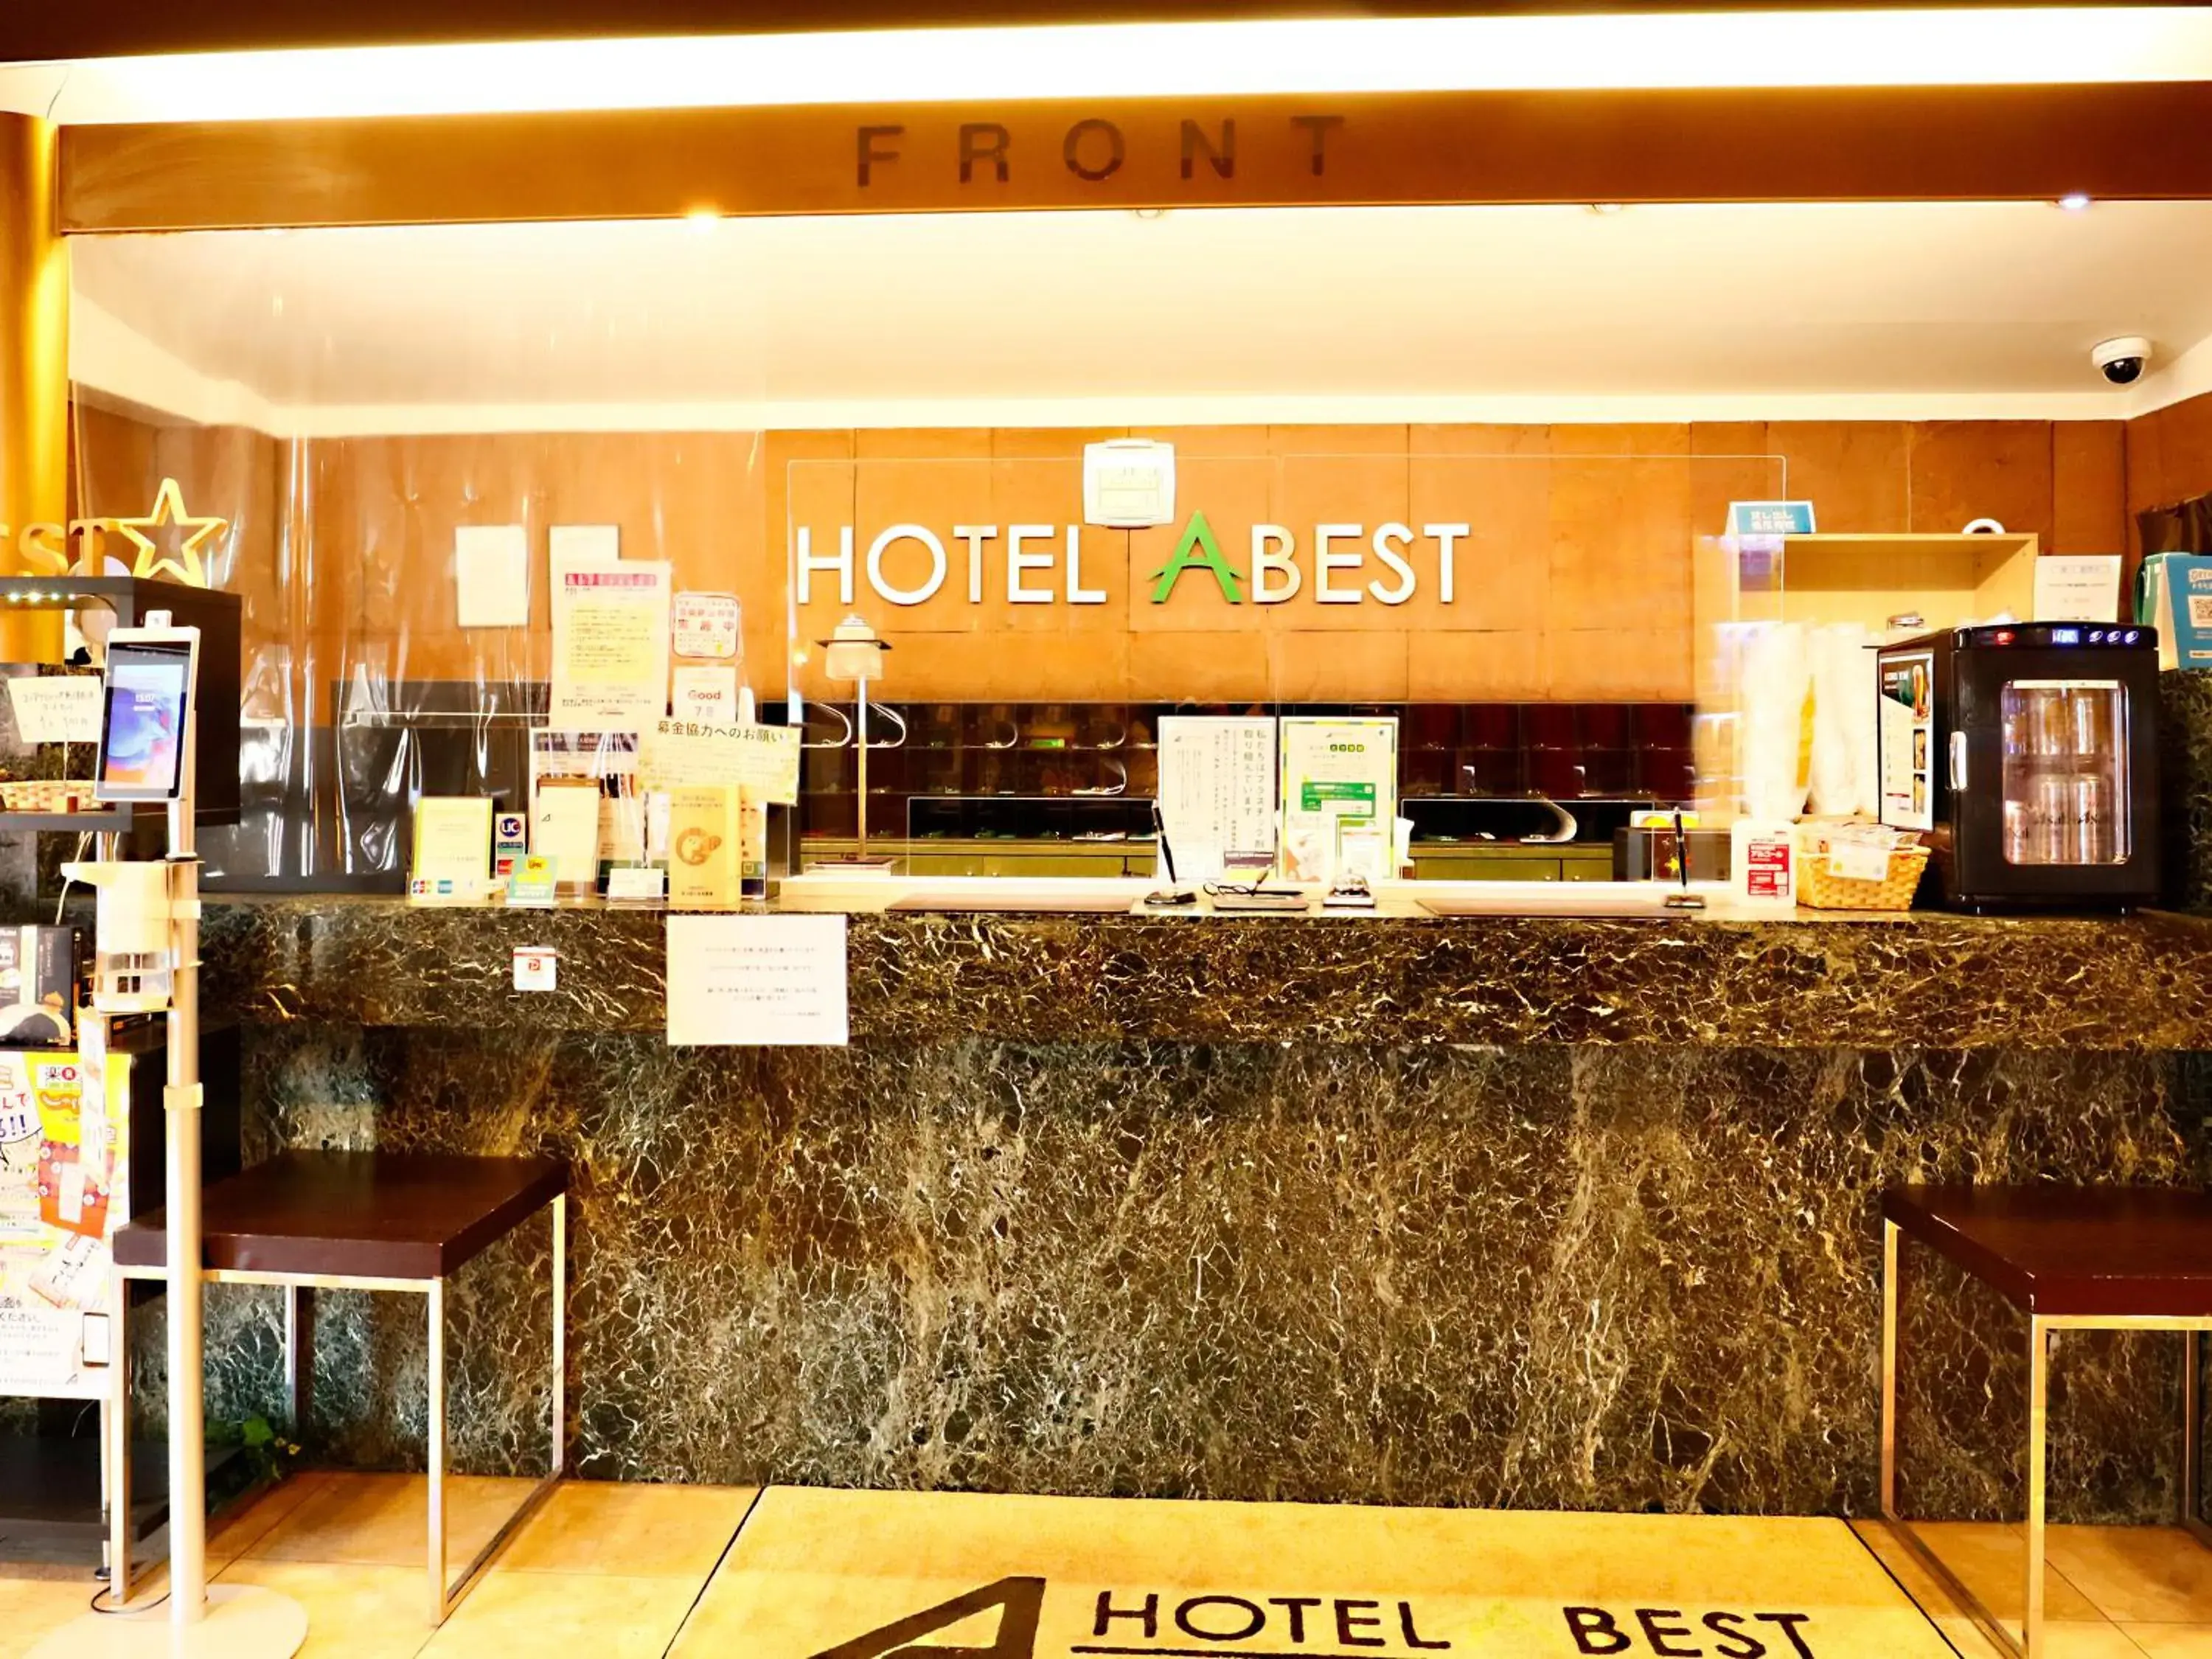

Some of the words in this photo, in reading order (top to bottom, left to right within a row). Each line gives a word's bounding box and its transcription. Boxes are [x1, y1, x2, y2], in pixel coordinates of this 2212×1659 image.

[857, 115, 1345, 187] FRONT
[0, 518, 110, 577] ST
[796, 524, 1107, 606] HOTEL
[658, 720, 785, 743] 募金協力へのお願い
[1092, 1590, 1452, 1650] HOTEL
[1562, 1606, 1815, 1659] BEST
